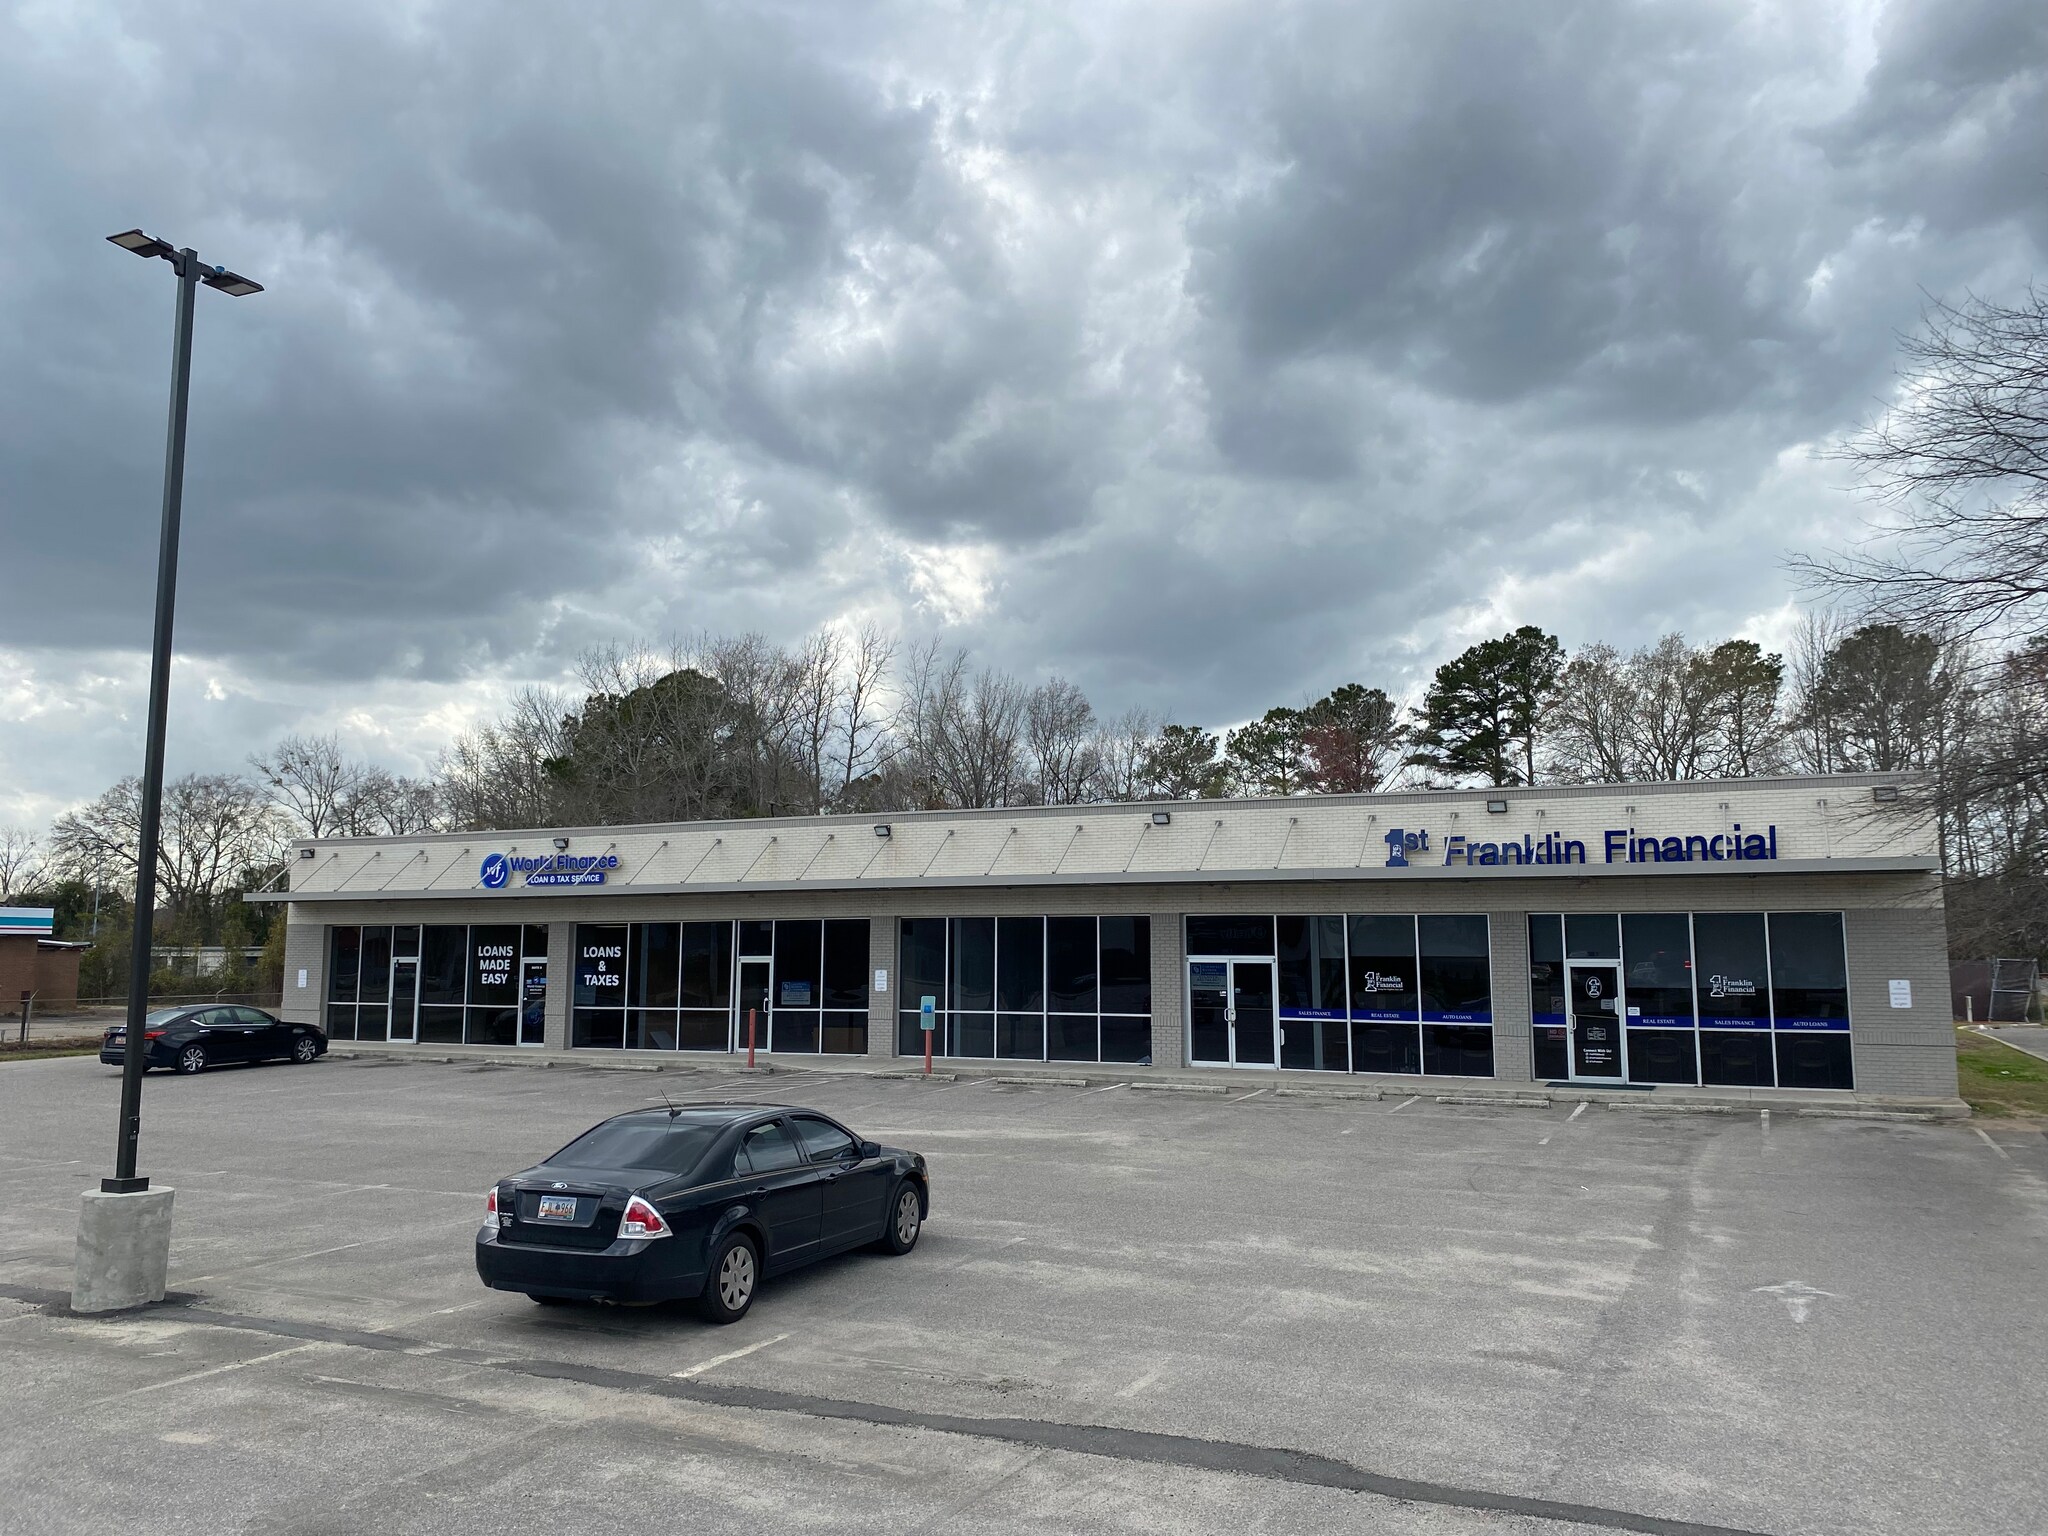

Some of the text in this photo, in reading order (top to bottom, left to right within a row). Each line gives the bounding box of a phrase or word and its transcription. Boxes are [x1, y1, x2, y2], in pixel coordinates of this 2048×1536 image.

[1384, 824, 1777, 867] 1st Franklin Financial
[510, 854, 618, 871] World Finance
[557, 875, 569, 883] TAX
[571, 874, 600, 882] SERVICE
[478, 946, 513, 956] LOANS
[584, 946, 621, 957] LOANS
[479, 960, 510, 970] MADE
[598, 961, 606, 971] &
[481, 974, 508, 984] EASY
[584, 975, 619, 986] TAXES
[561, 1203, 574, 1214] 966
